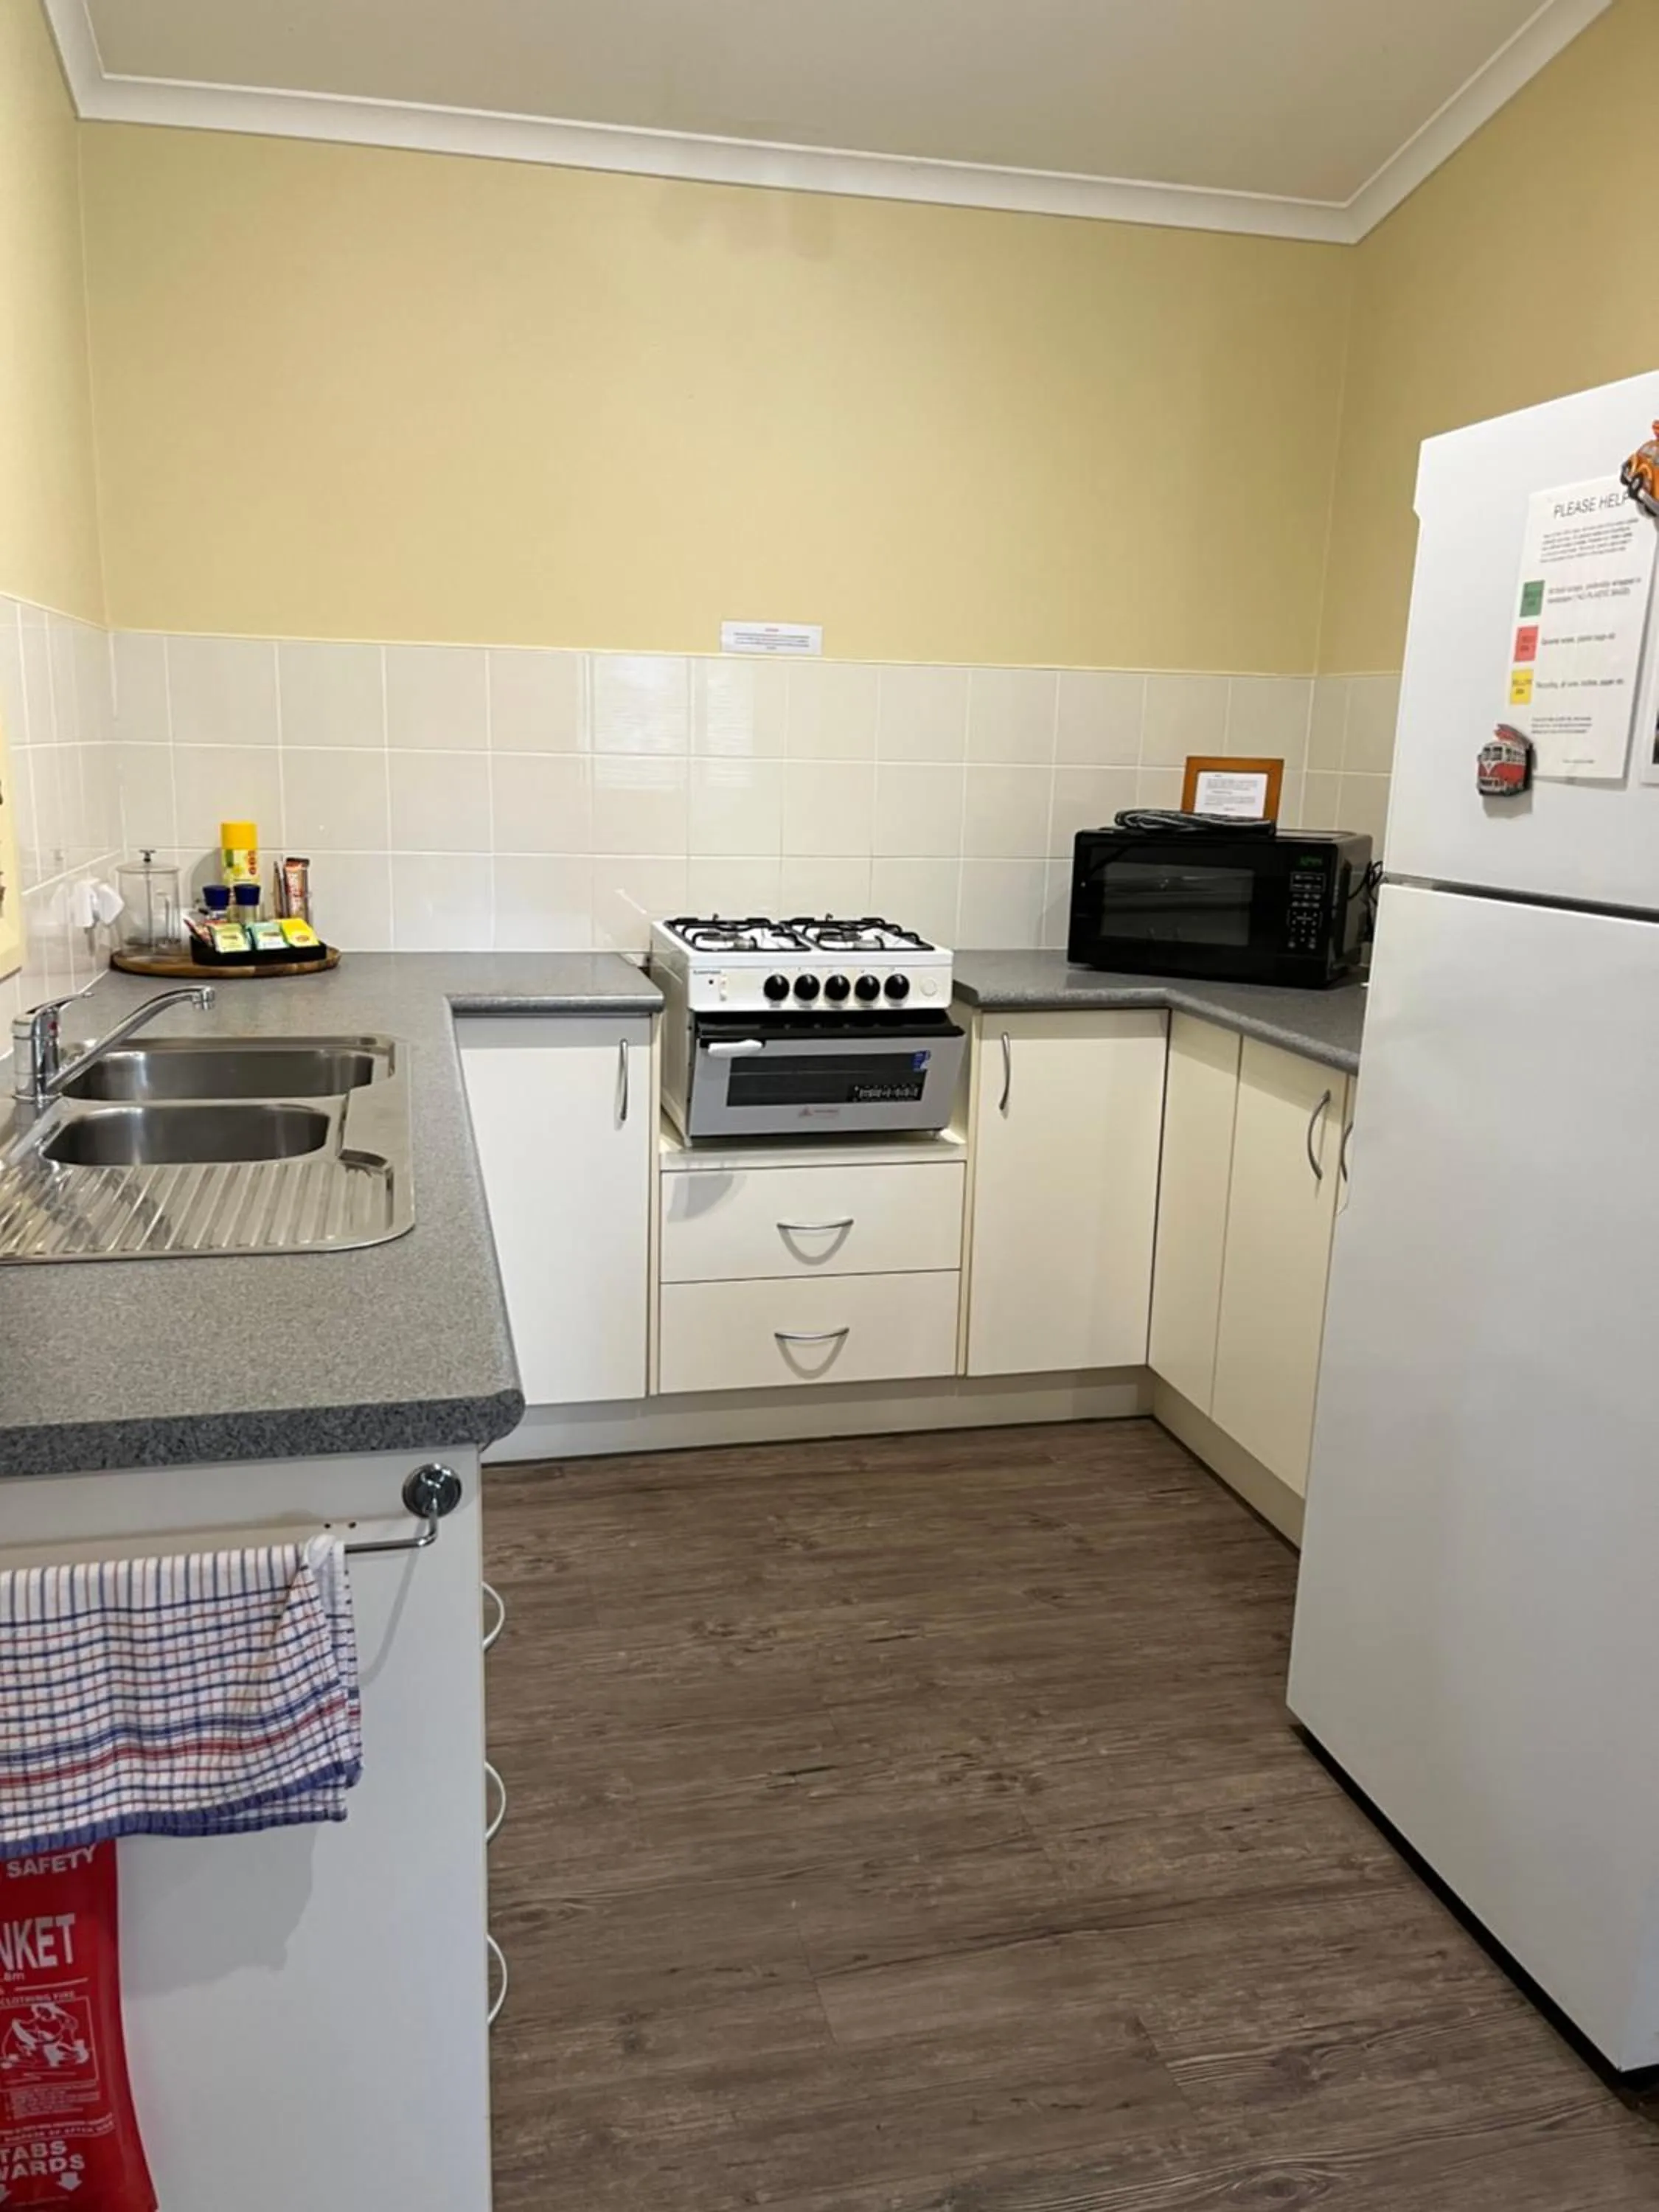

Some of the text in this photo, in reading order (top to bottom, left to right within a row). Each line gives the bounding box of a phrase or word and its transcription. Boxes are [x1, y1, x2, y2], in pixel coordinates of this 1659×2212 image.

[1554, 496, 1596, 518] PLEASE
[7, 1844, 95, 1878] SAFETY
[0, 2140, 67, 2163] TABS
